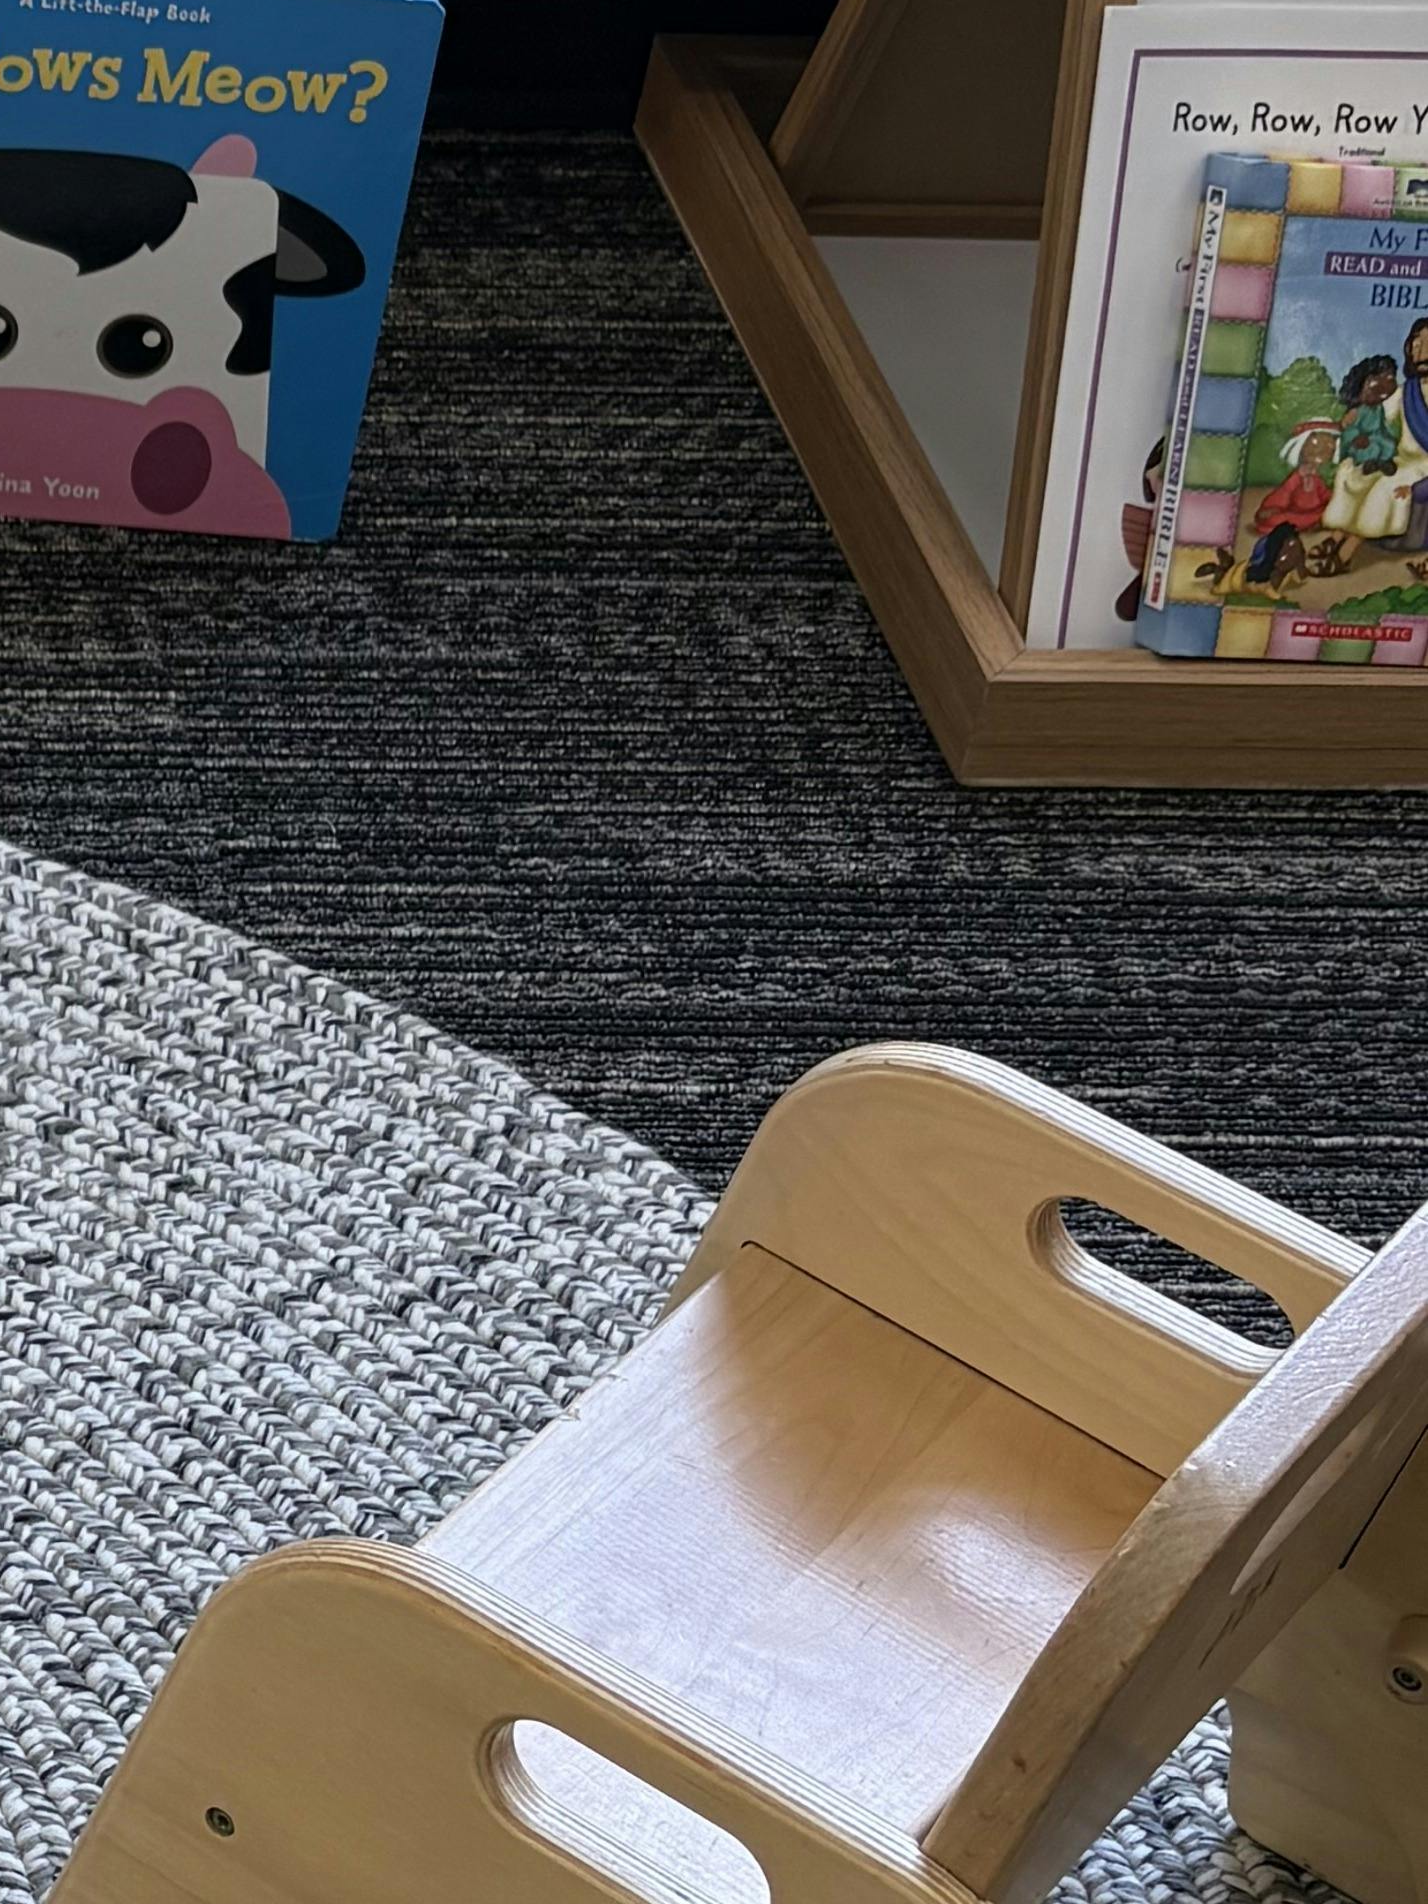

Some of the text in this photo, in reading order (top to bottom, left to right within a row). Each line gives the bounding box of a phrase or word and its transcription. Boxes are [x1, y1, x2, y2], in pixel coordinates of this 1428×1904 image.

[166, 3, 212, 25] Book
[136, 48, 388, 123] Meow?
[1172, 102, 1239, 136] Row,
[1251, 102, 1321, 136] Row,
[1334, 103, 1398, 134] Row
[1204, 211, 1219, 248] My
[1369, 226, 1406, 254] My
[1330, 255, 1422, 276] READ and
[43, 475, 101, 502] Yoon
[1308, 624, 1410, 639] SCHOLASTIC
